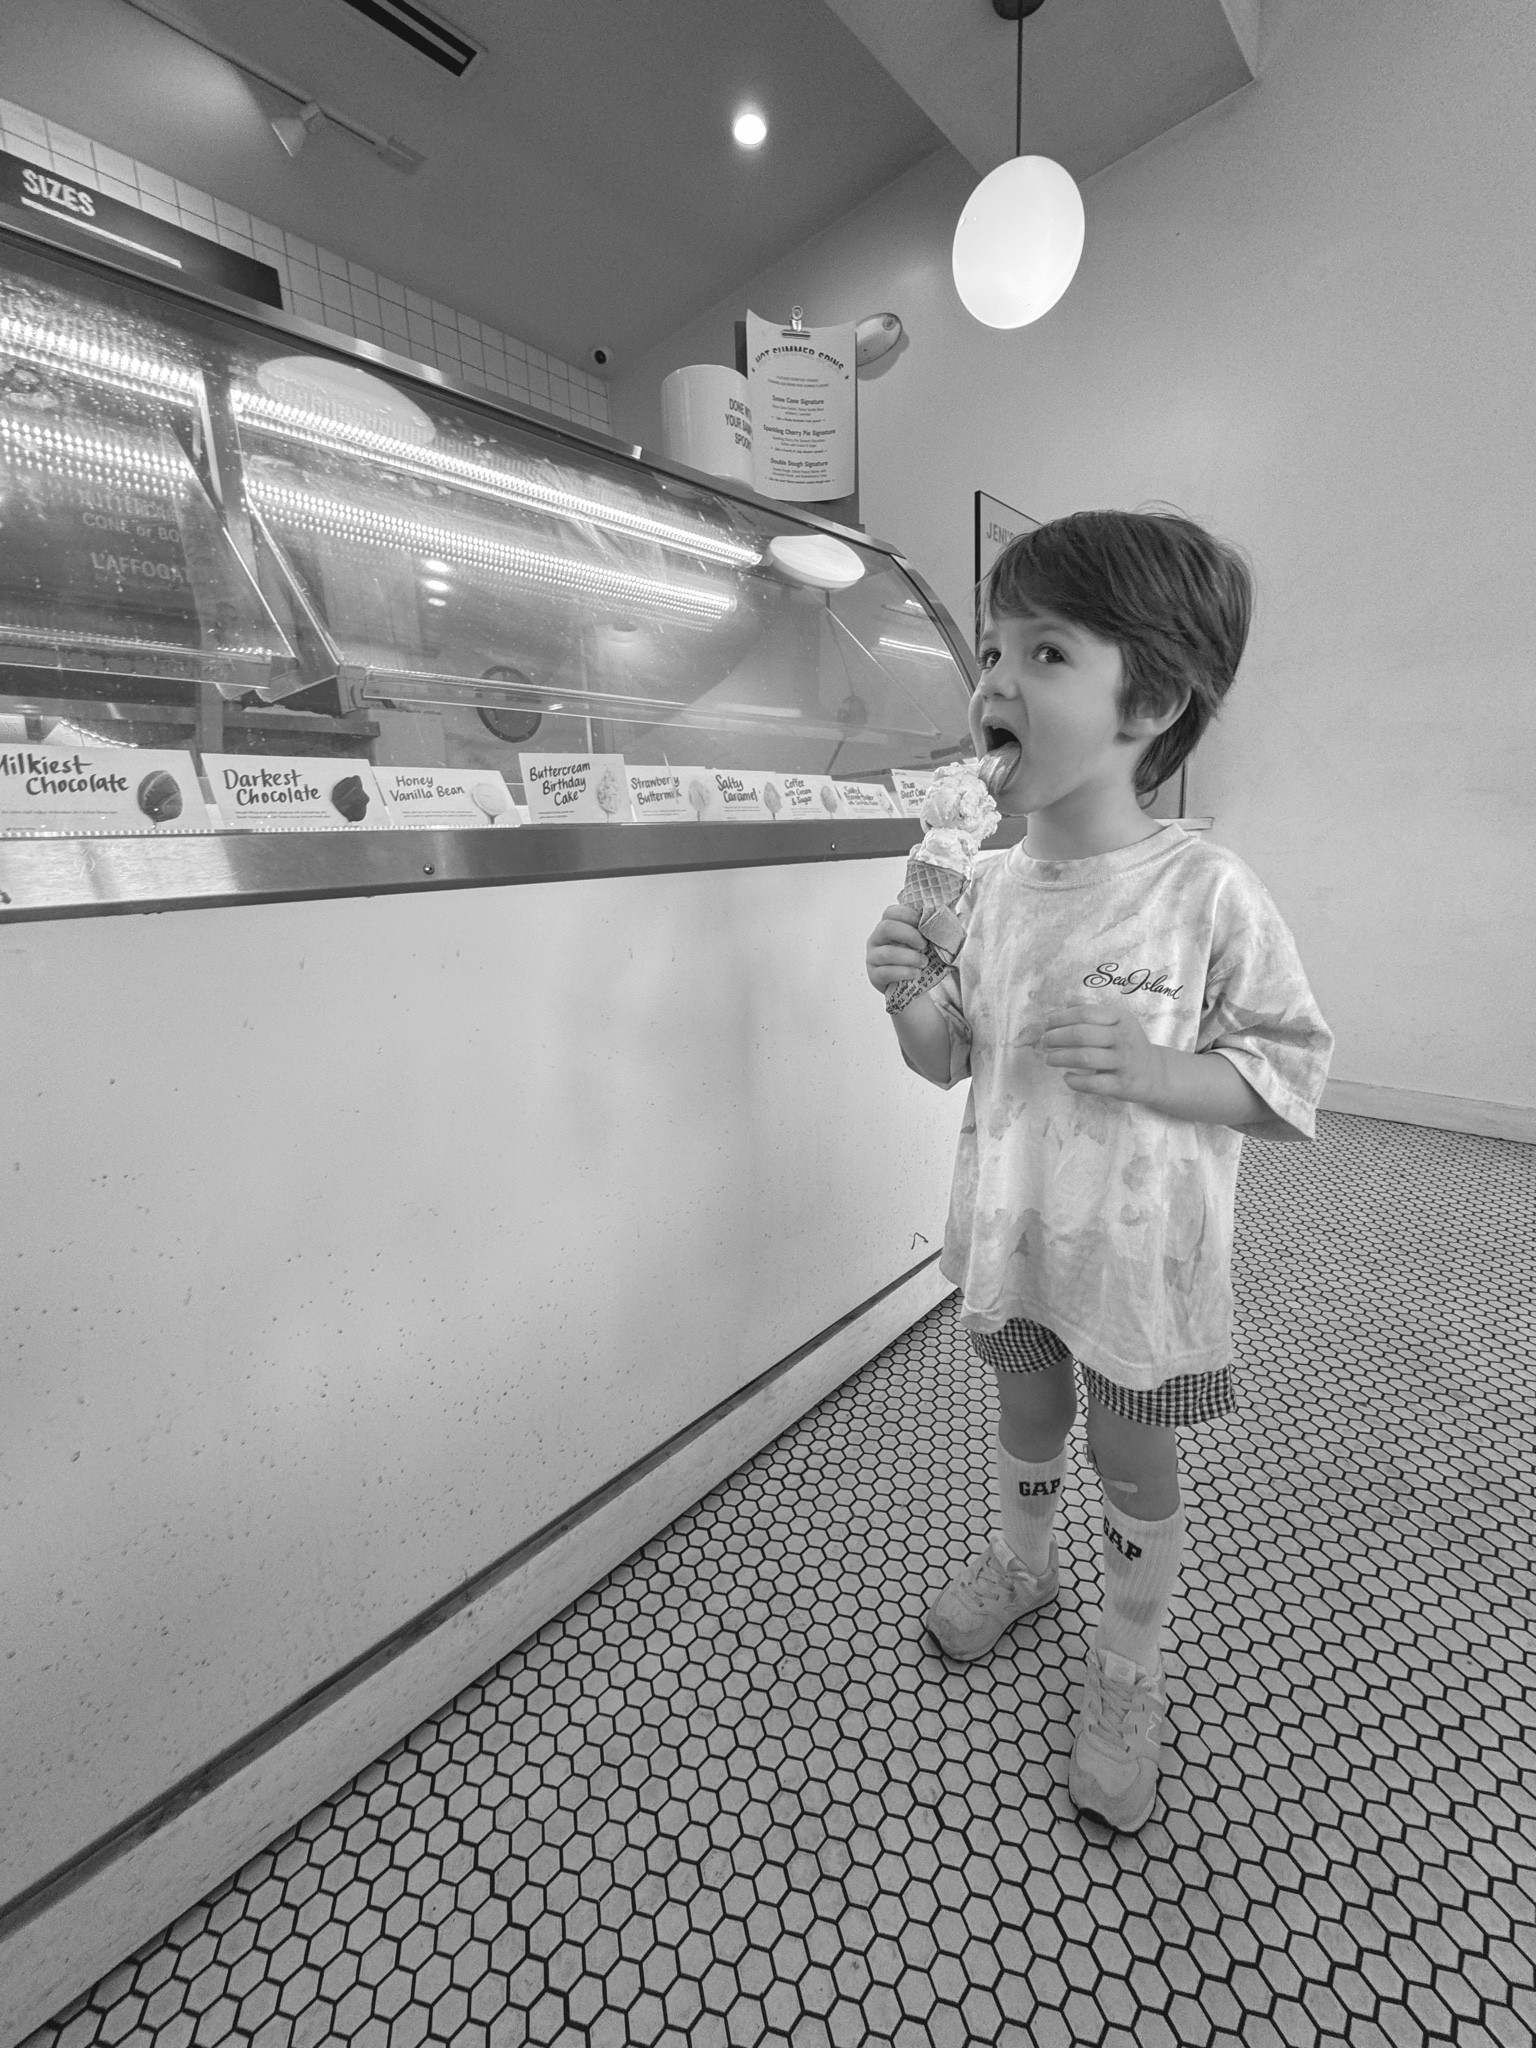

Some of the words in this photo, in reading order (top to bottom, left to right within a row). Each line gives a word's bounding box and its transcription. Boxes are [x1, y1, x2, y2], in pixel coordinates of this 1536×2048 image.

[21, 168, 96, 217] SIZES
[724, 413, 743, 430] YOUR
[158, 526, 180, 542] BO
[222, 768, 303, 790] Darkest
[395, 775, 434, 788] Honey
[529, 762, 591, 782] Buttercream
[26, 773, 129, 795] Chocolate
[542, 776, 587, 796] Birthday
[630, 776, 680, 790] Strawbery
[715, 774, 744, 792] Salty
[236, 784, 321, 806] Chocolate
[389, 788, 433, 802] Vanilla
[436, 785, 465, 798] Bean
[554, 790, 579, 806] Cake
[722, 787, 759, 803] Caramel
[1082, 961, 1126, 989] Sea
[1120, 968, 1184, 1000] Island
[1018, 1477, 1061, 1497] GAP
[1103, 1515, 1143, 1561] GAP
